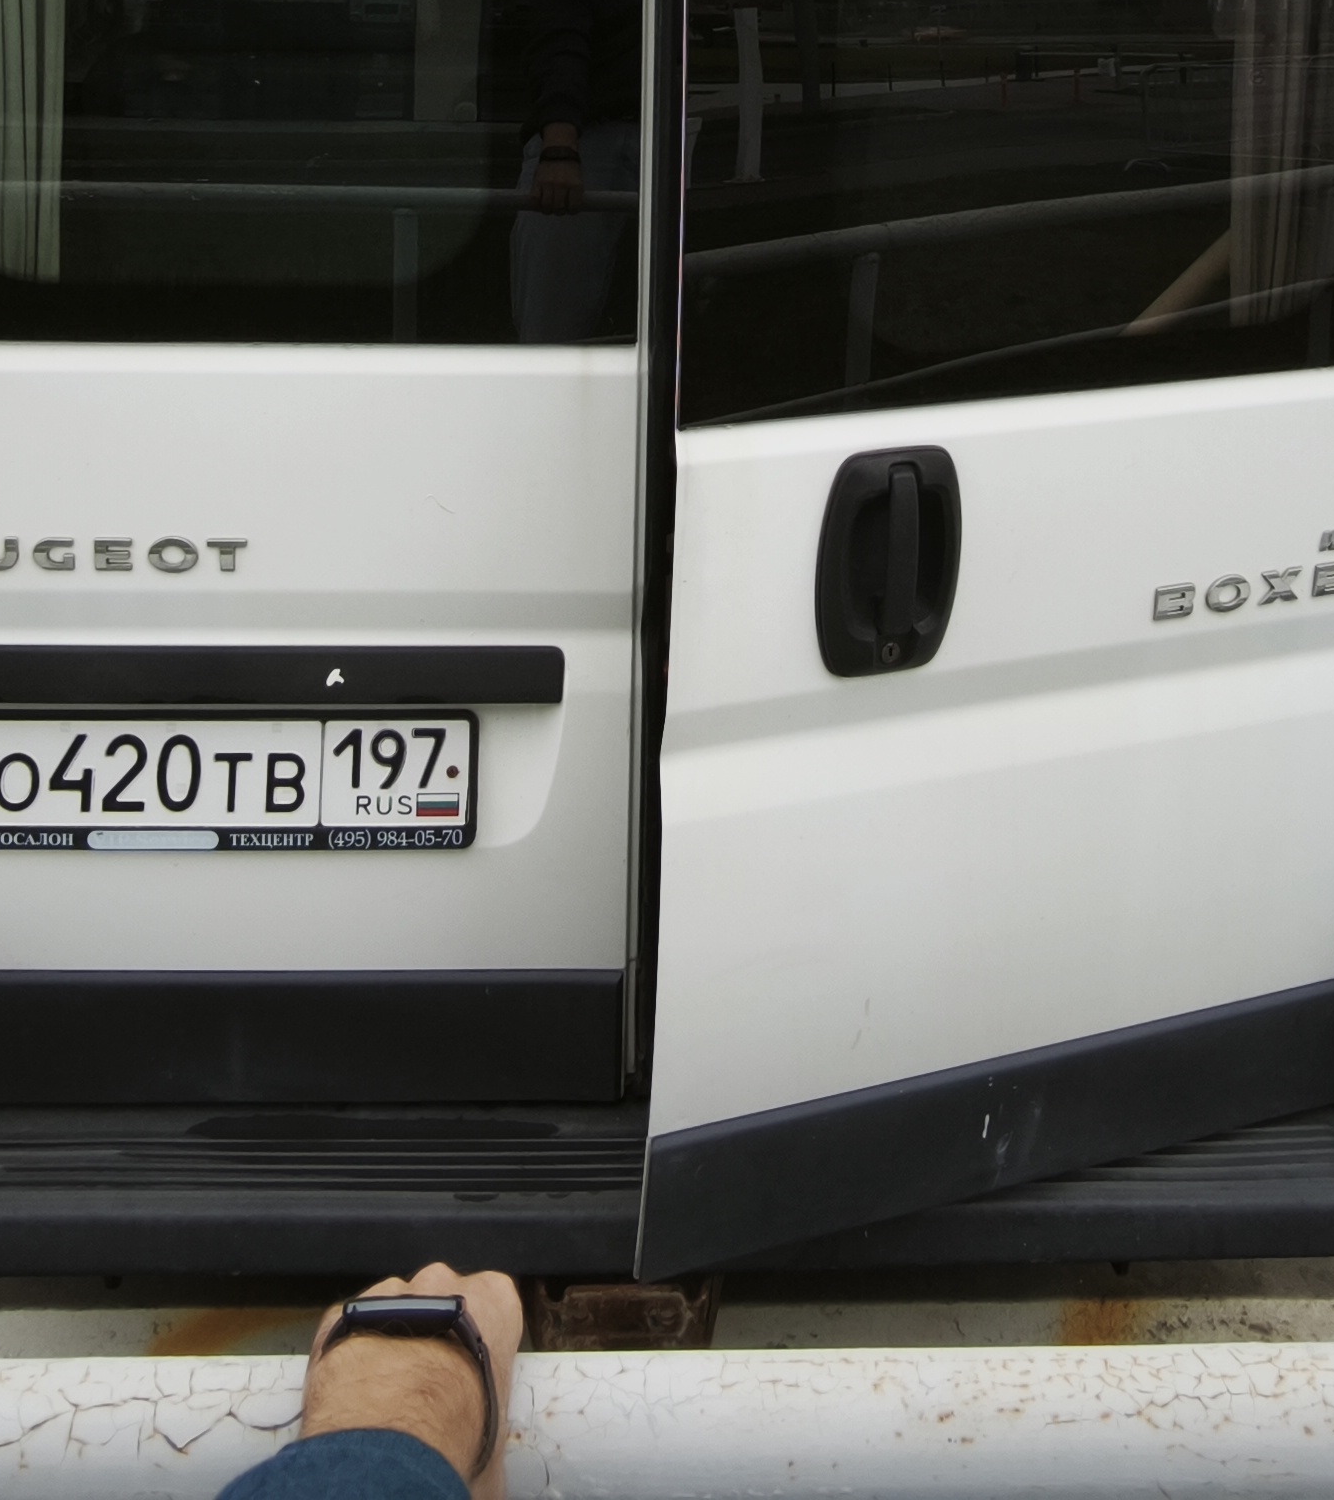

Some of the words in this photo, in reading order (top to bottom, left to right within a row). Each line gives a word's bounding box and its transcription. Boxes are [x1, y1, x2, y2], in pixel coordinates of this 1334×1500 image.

[332, 728, 446, 790] 197
[356, 795, 413, 816] RUS
[229, 833, 314, 848] ТЕХЦЕНТР
[328, 829, 372, 849] (495)
[378, 828, 463, 847] 984-05-70
